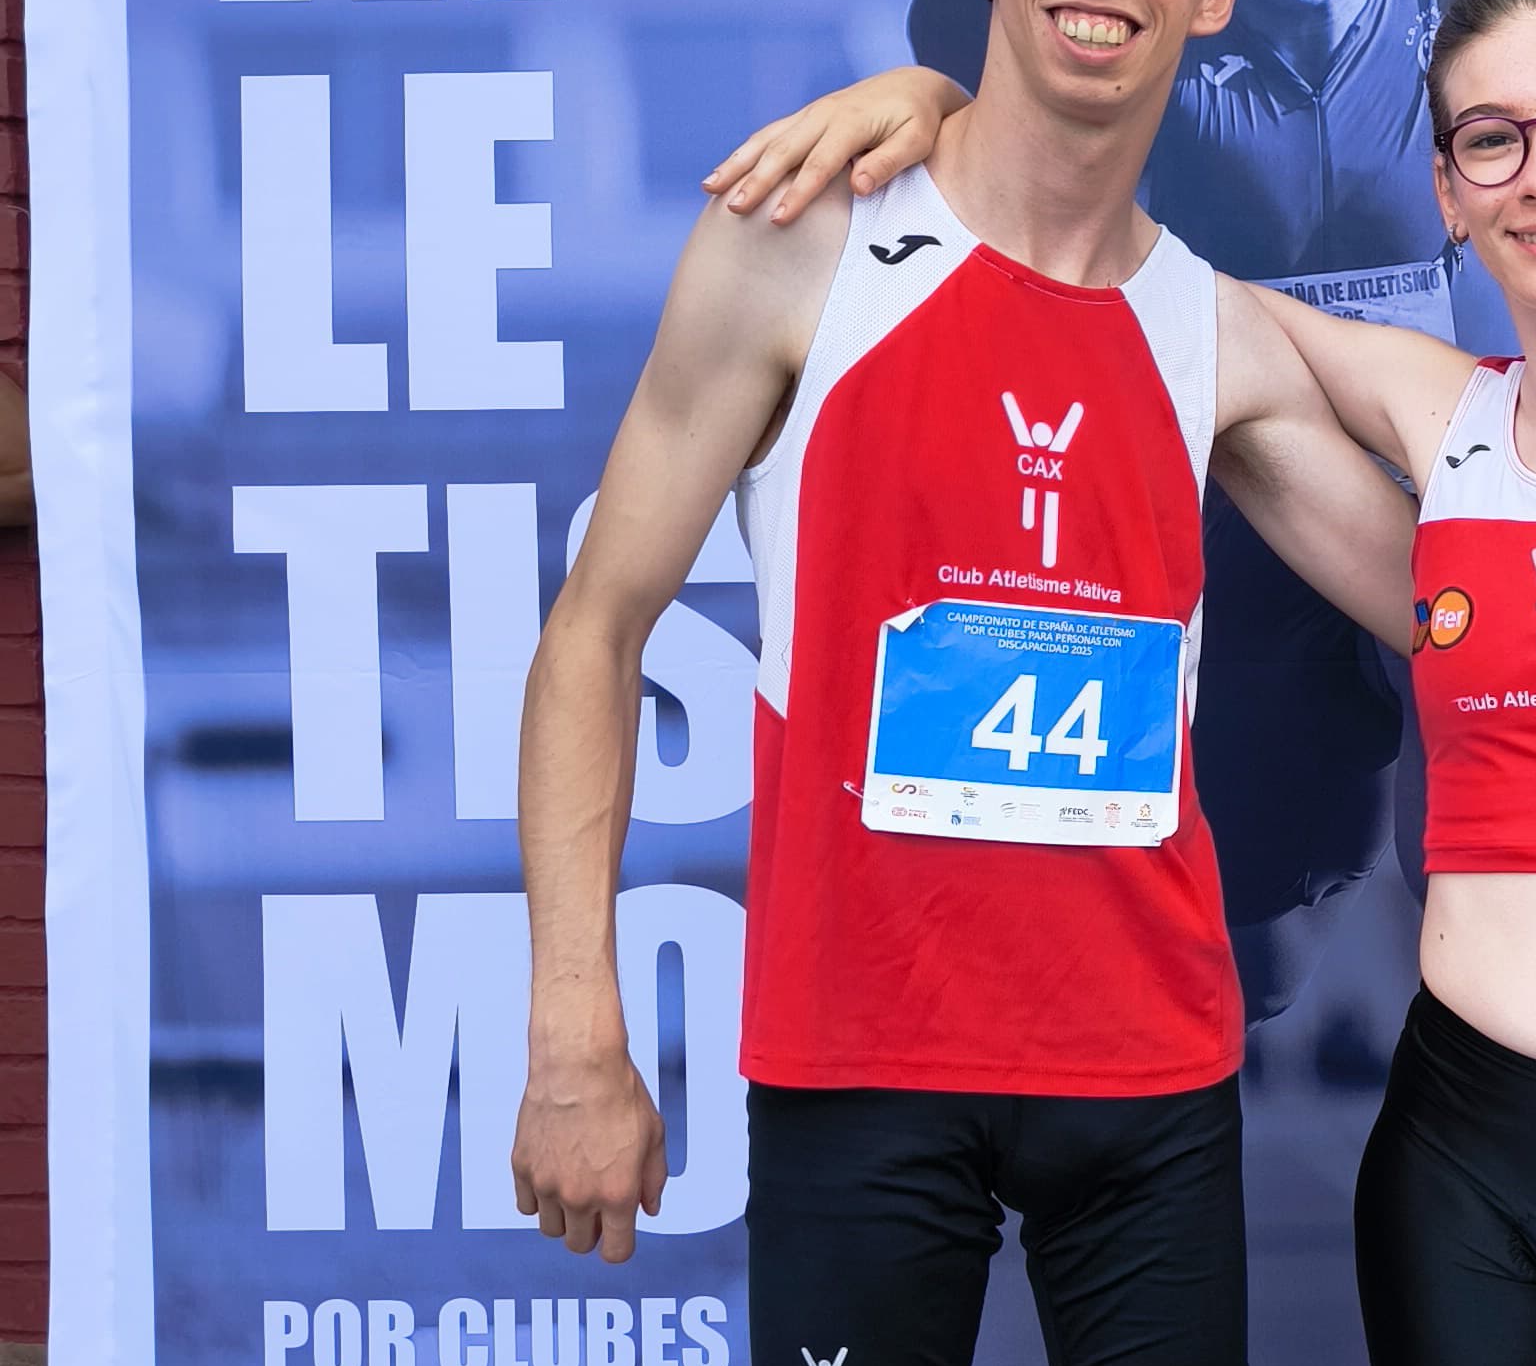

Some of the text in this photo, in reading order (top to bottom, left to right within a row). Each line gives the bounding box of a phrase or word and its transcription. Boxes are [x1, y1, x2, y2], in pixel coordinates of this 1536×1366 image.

[240, 70, 565, 413] LE
[1322, 283, 1345, 304] DE
[1347, 267, 1441, 301] ATLETISMO
[1017, 453, 1064, 481] CAX
[937, 565, 1121, 603] Club Atletisme Xàtiva
[947, 612, 1136, 638] CAMPEONATO DE ESPAÑA DE ATLETISMO
[1433, 609, 1465, 631] Fer
[964, 625, 1121, 647] POR CLUBES PARA PERSONAS CON
[998, 639, 1069, 654] DISCAPACIDAD
[1456, 693, 1498, 712] Club
[971, 673, 1108, 775] 44
[261, 883, 749, 1235] MO
